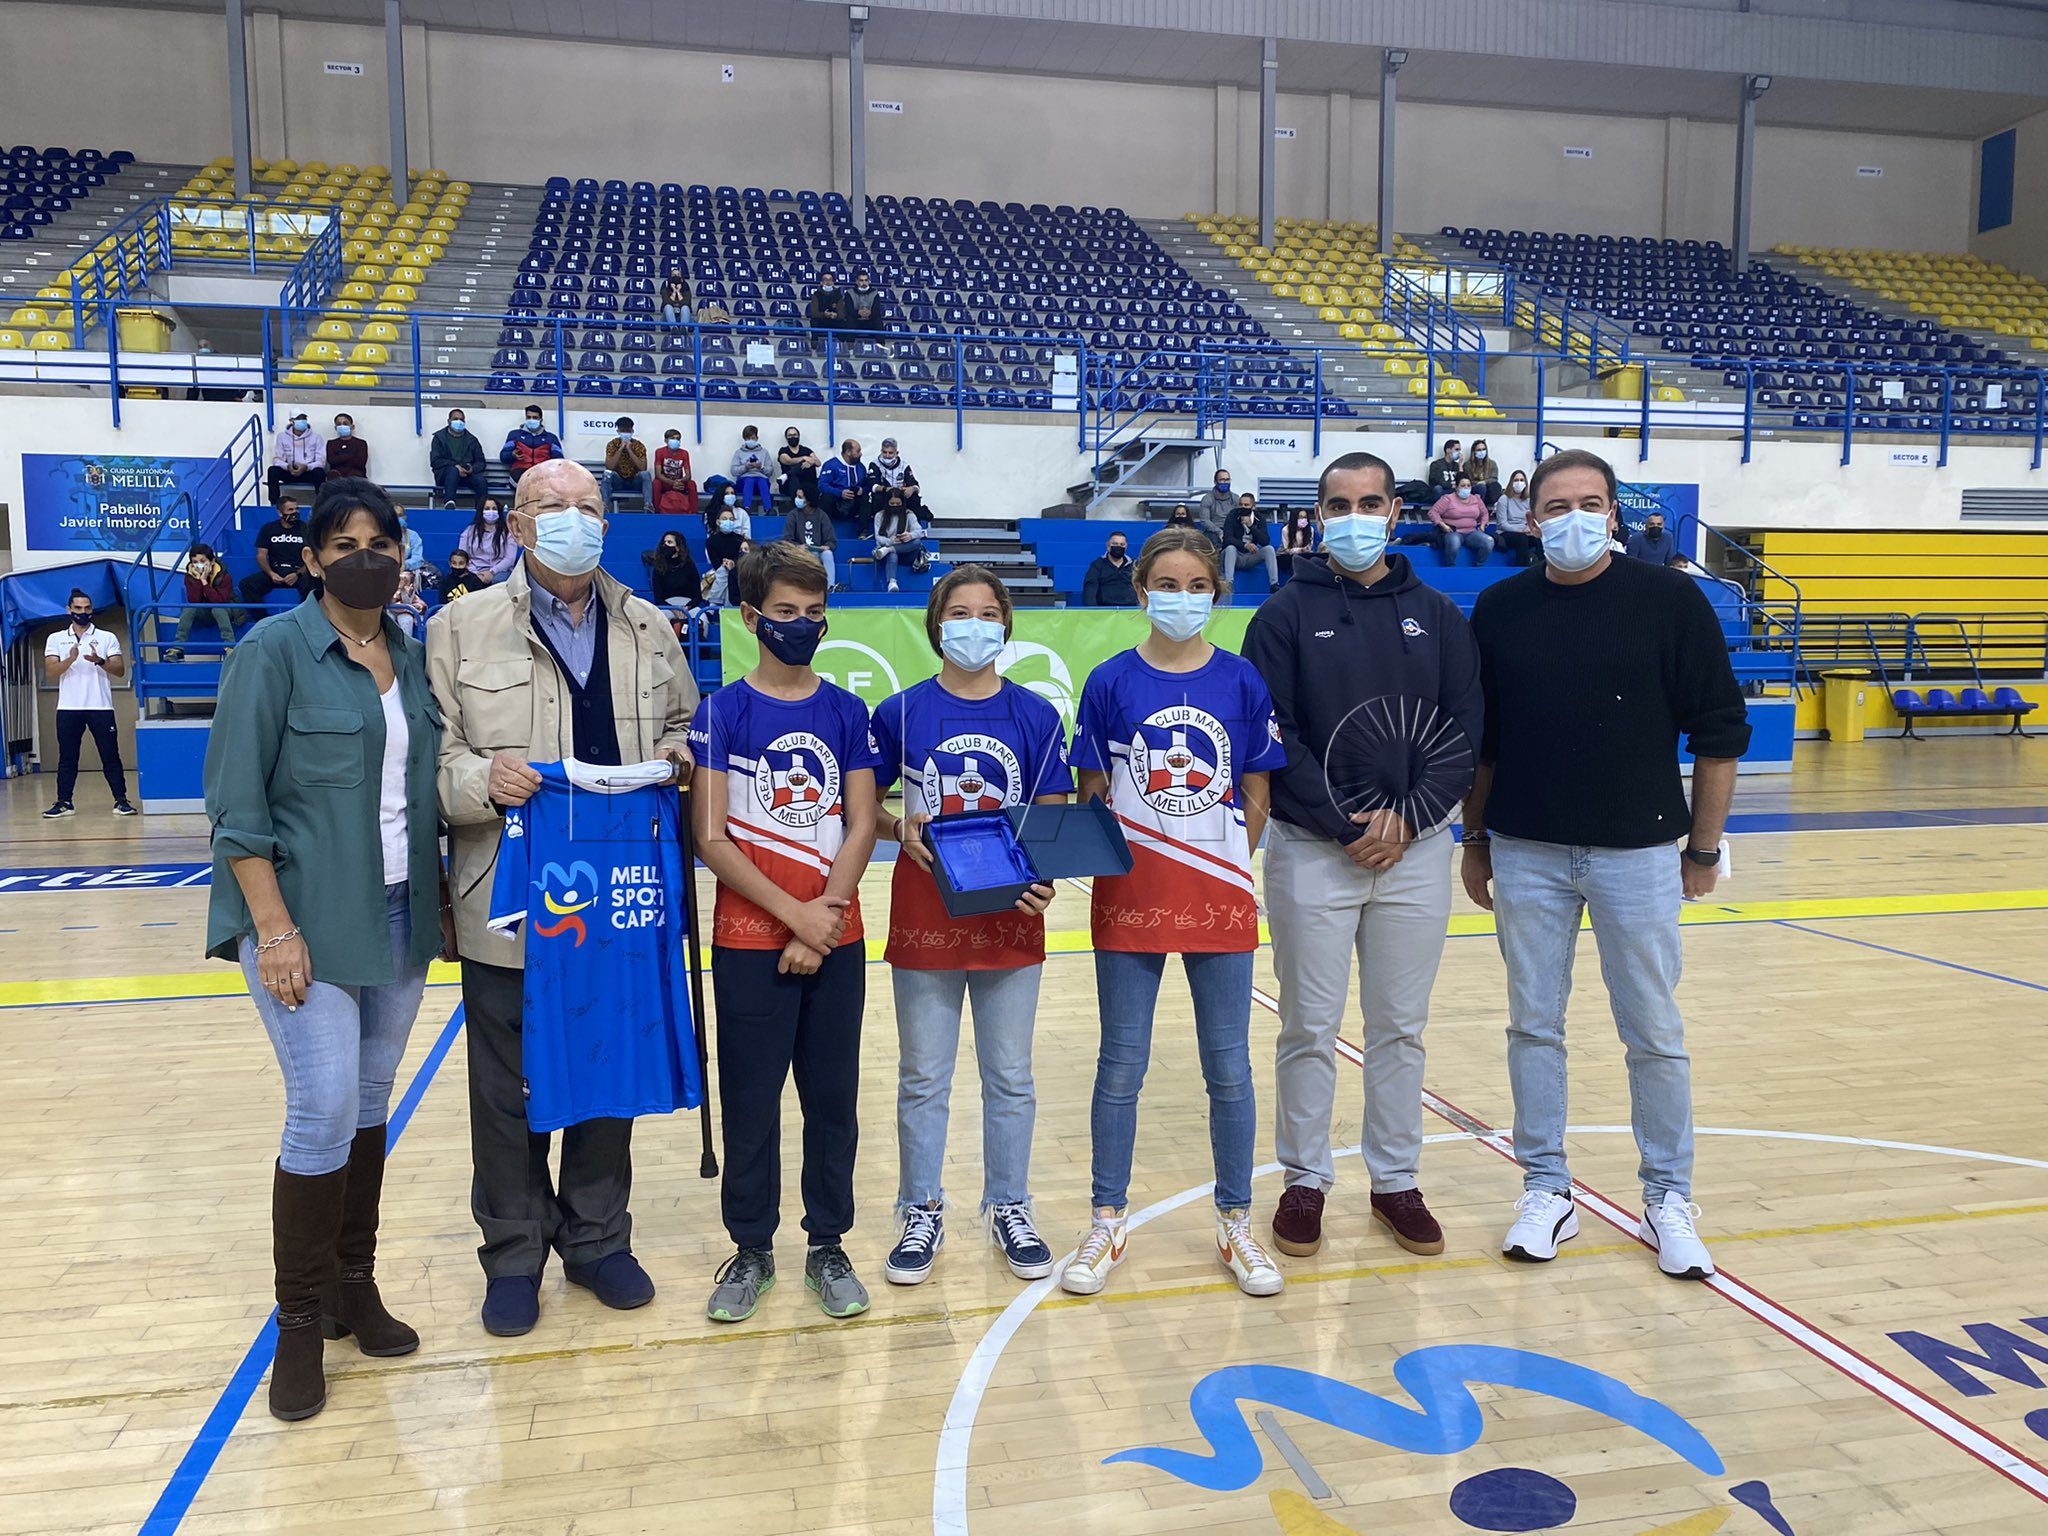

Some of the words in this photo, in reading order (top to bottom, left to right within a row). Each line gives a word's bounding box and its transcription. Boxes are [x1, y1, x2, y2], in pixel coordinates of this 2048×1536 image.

[354, 66, 360, 74] 3
[1253, 437, 1286, 446] SECTOR
[1288, 438, 1296, 449] 4
[1893, 453, 1920, 461] SECTOR
[1922, 454, 1928, 464] 5
[109, 467, 135, 475] CIUDAD
[135, 466, 175, 475] AUTÓNOMA
[112, 474, 176, 488] MELILLA
[100, 502, 161, 515] Pabellón
[59, 516, 103, 529] Javier
[168, 517, 202, 529] Ort
[271, 534, 304, 544] adidas
[1155, 709, 1191, 727] CLUB
[1194, 712, 1231, 779] MARITIMO
[763, 767, 772, 802] REAL
[776, 735, 807, 751] CLUB
[810, 736, 839, 796] MARITIMO
[1136, 745, 1147, 785] REAL
[930, 770, 939, 809] REAL
[947, 737, 982, 753] CLUB
[985, 740, 1021, 803] MARITIMO
[1153, 788, 1220, 813] MELILLA
[1885, 1316, 2048, 1398] M
